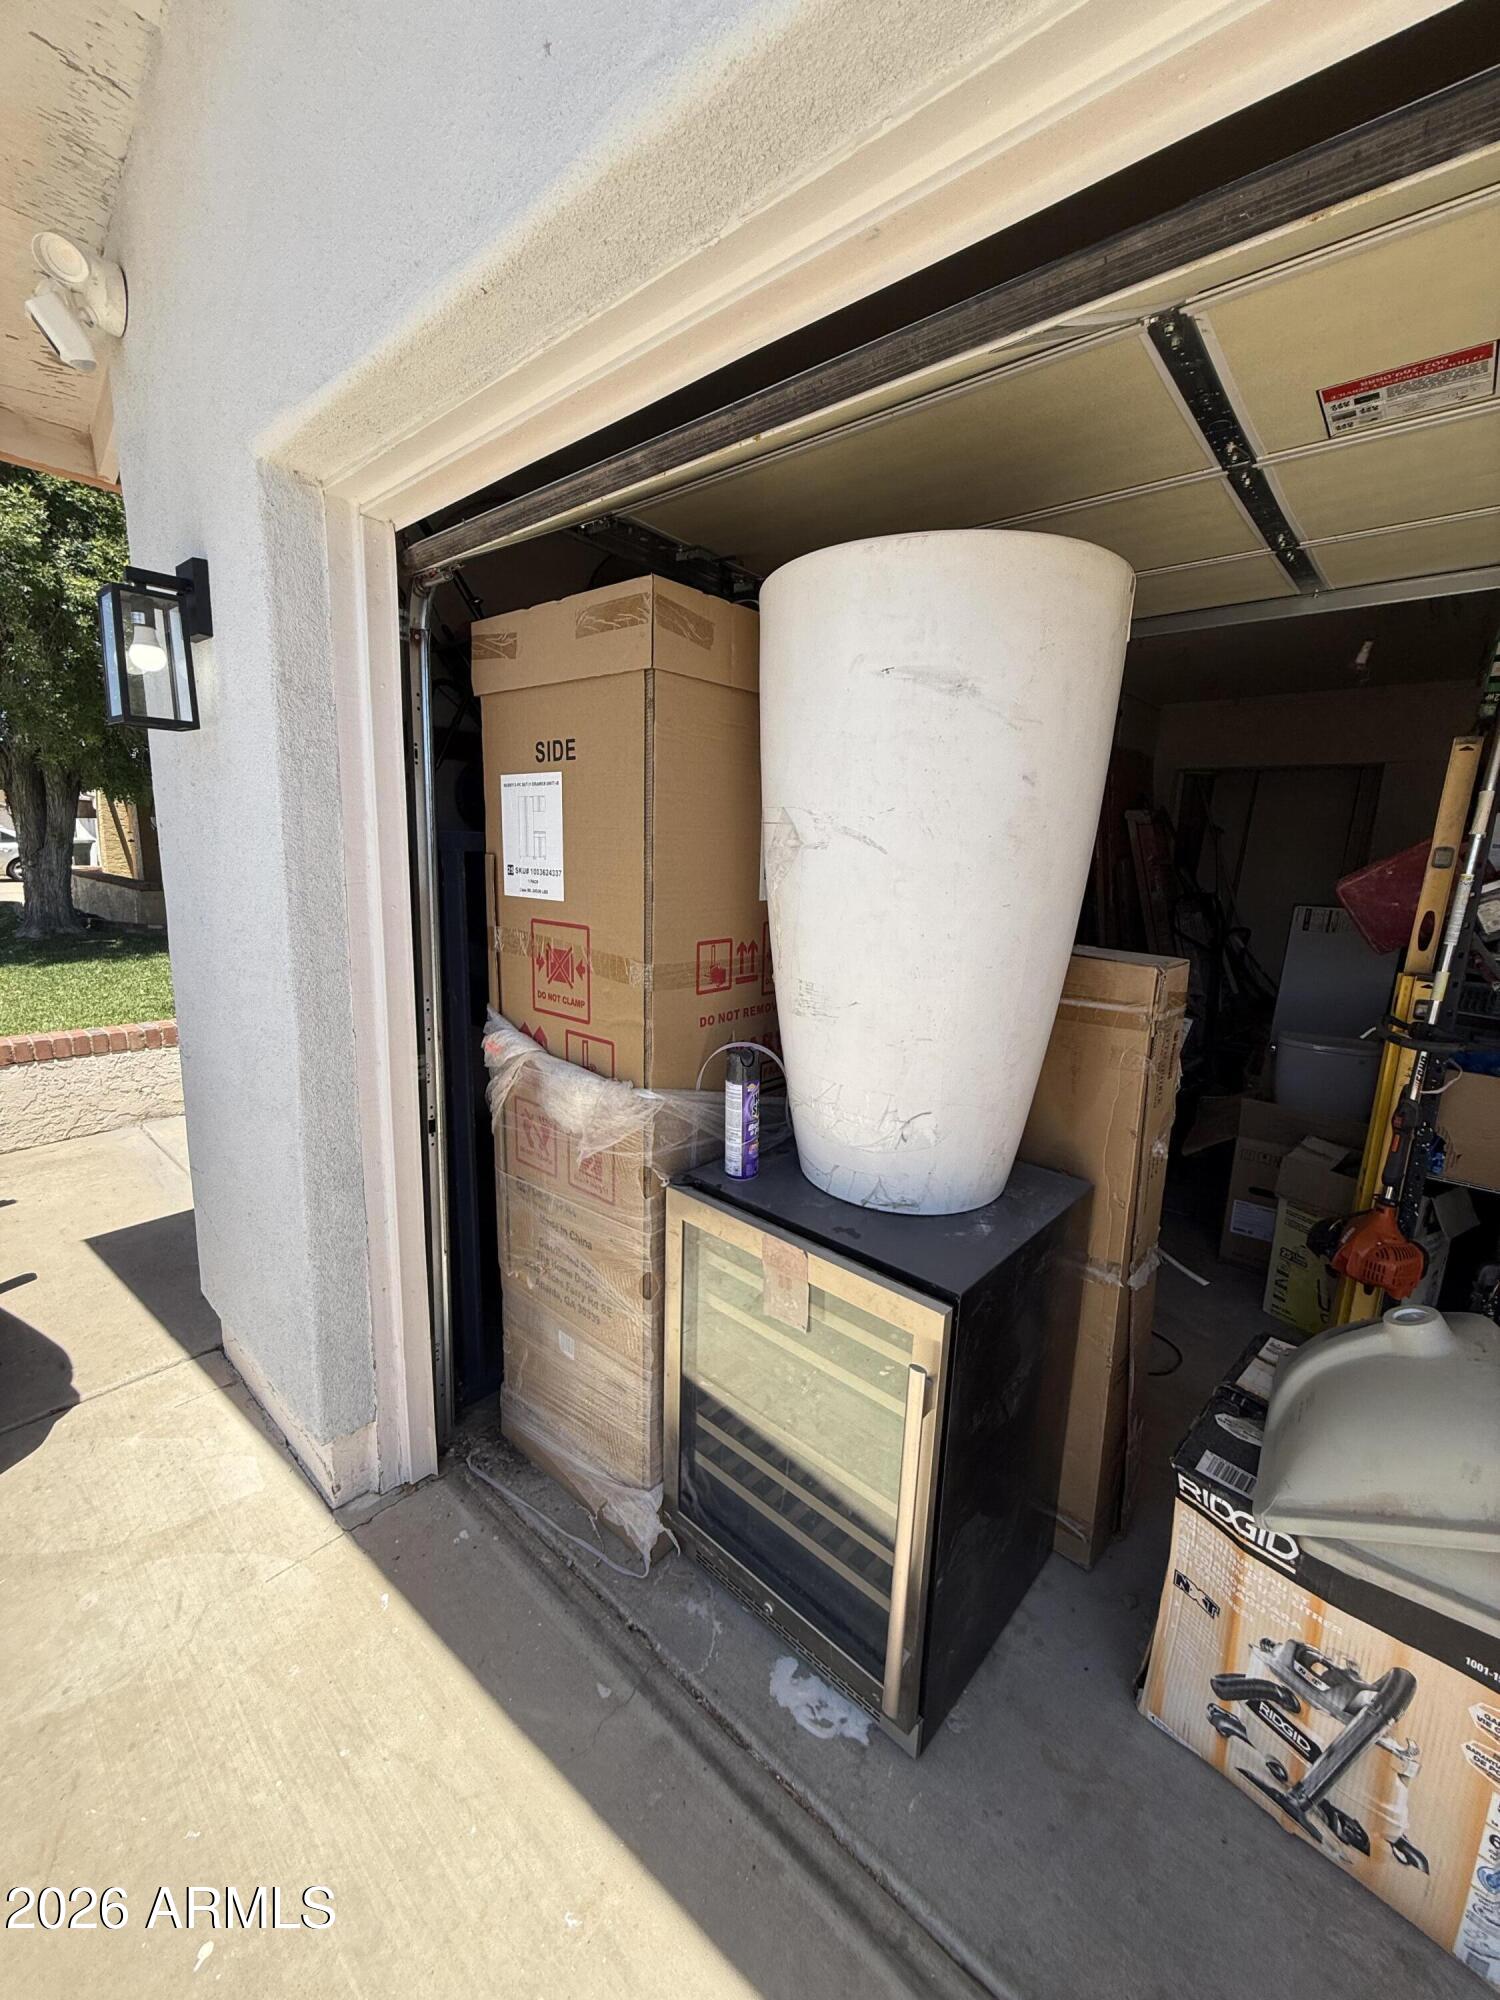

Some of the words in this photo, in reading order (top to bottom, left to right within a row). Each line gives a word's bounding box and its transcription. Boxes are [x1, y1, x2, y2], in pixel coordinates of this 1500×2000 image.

[535, 738, 576, 763] SIDE
[537, 990, 546, 999] DO
[548, 993, 560, 1003] NOT
[562, 996, 586, 1008] CLAMP
[700, 1015, 715, 1028] DO
[718, 1009, 740, 1024] NOT
[569, 1230, 593, 1250] China
[1177, 1472, 1300, 1561] RIDGID
[1175, 1570, 1220, 1619] NXT
[1259, 1701, 1311, 1751] RIDGID
